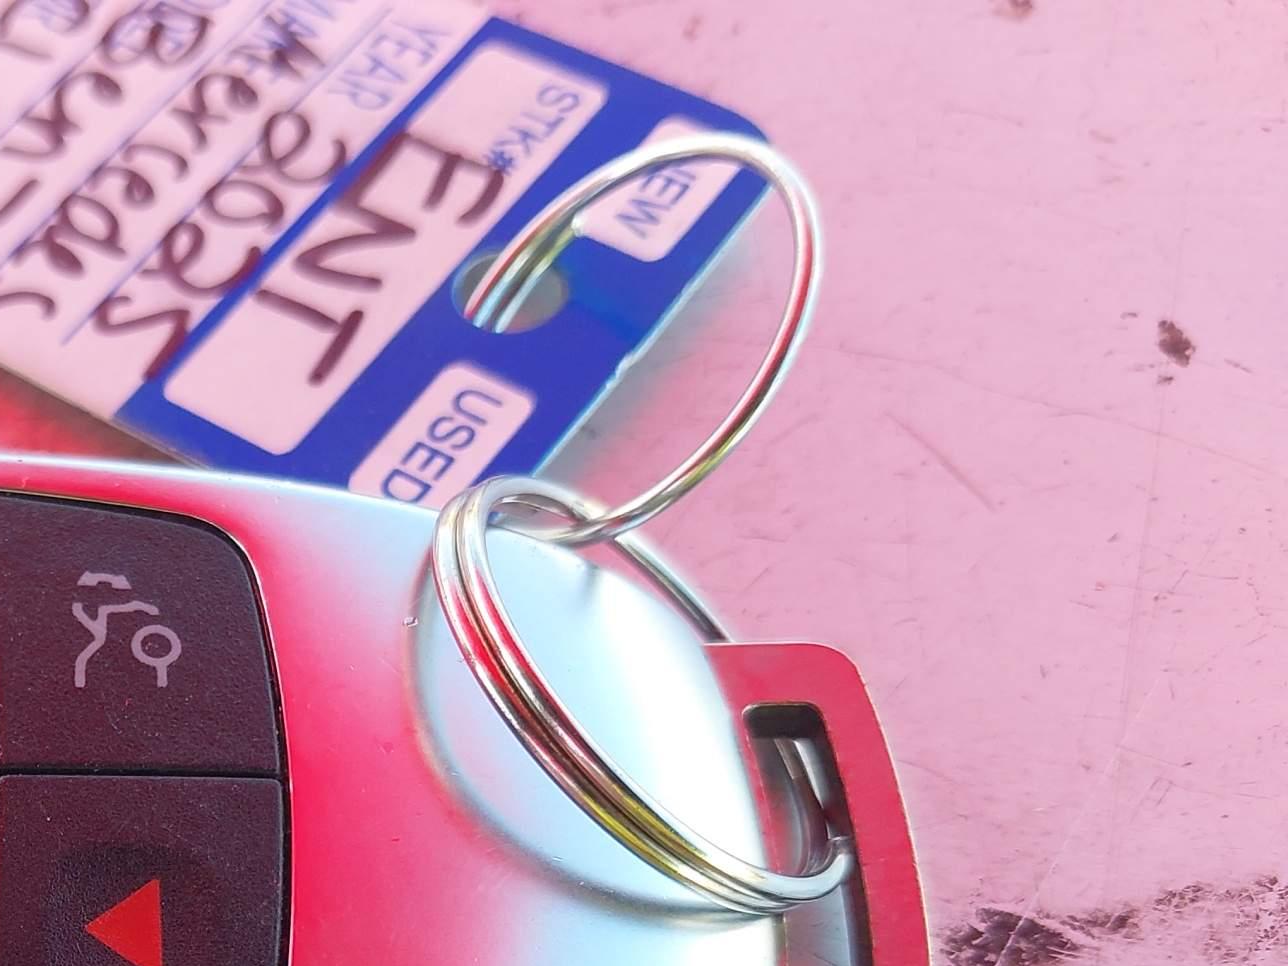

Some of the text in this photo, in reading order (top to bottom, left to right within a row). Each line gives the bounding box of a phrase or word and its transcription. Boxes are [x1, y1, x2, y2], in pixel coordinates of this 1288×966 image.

[326, 19, 452, 111] YEAR
[480, 84, 580, 177] STK#
[91, 109, 348, 384] 2025
[254, 131, 505, 386] ENT
[382, 389, 504, 504] USED
